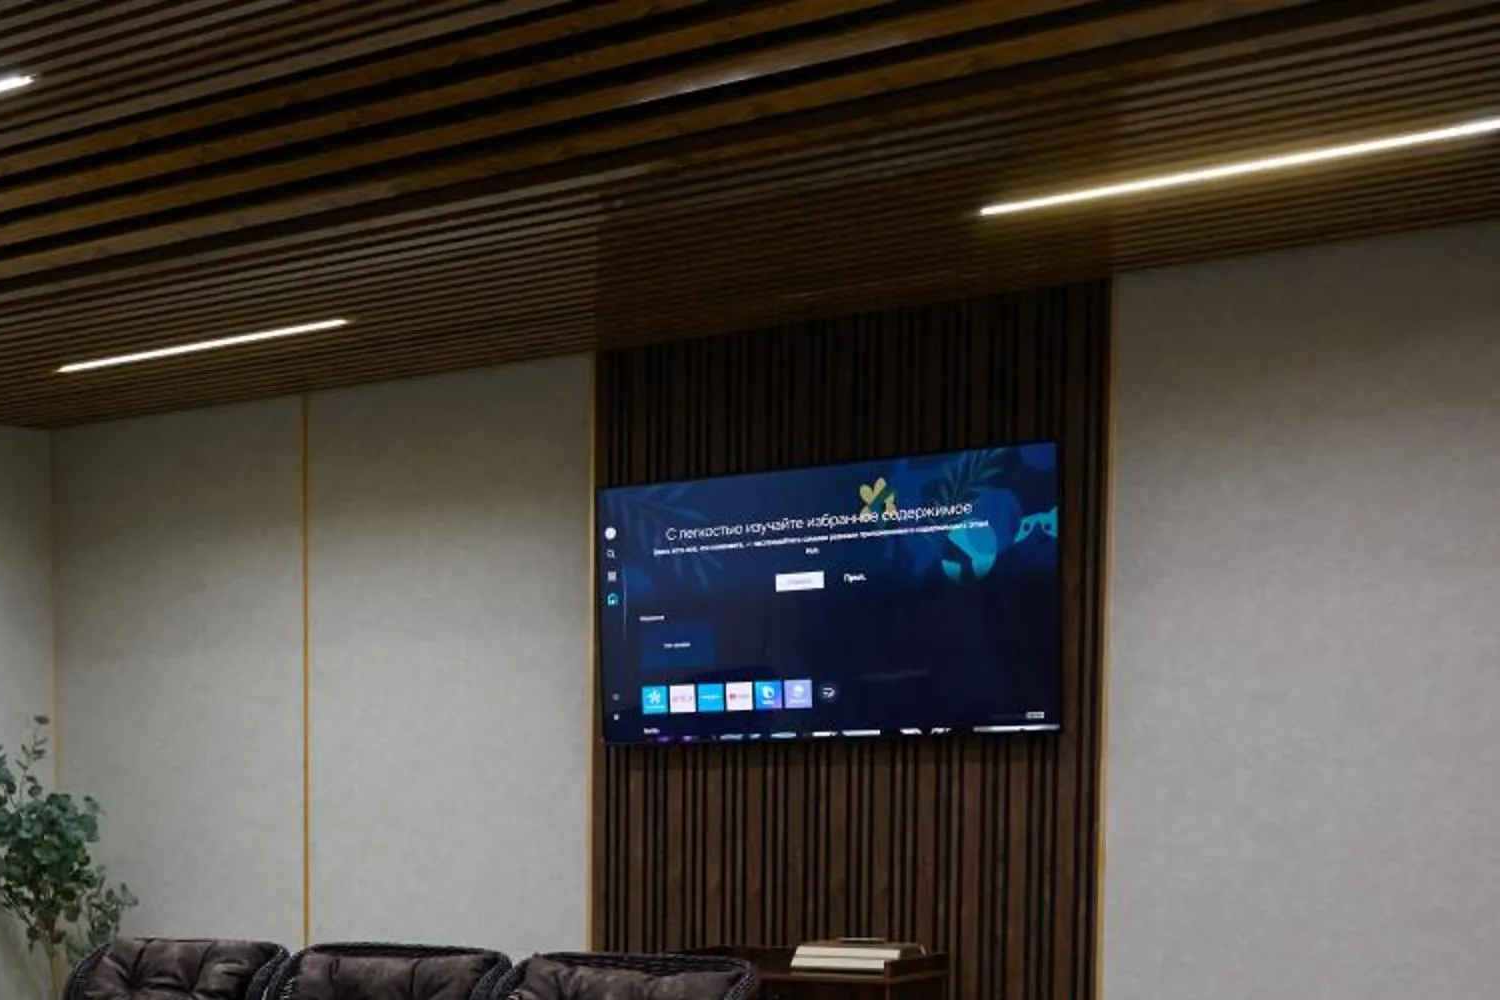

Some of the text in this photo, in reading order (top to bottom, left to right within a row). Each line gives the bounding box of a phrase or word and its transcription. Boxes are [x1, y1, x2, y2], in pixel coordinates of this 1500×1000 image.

[665, 503, 973, 541] С легкостью изучайте избранное содержимое
